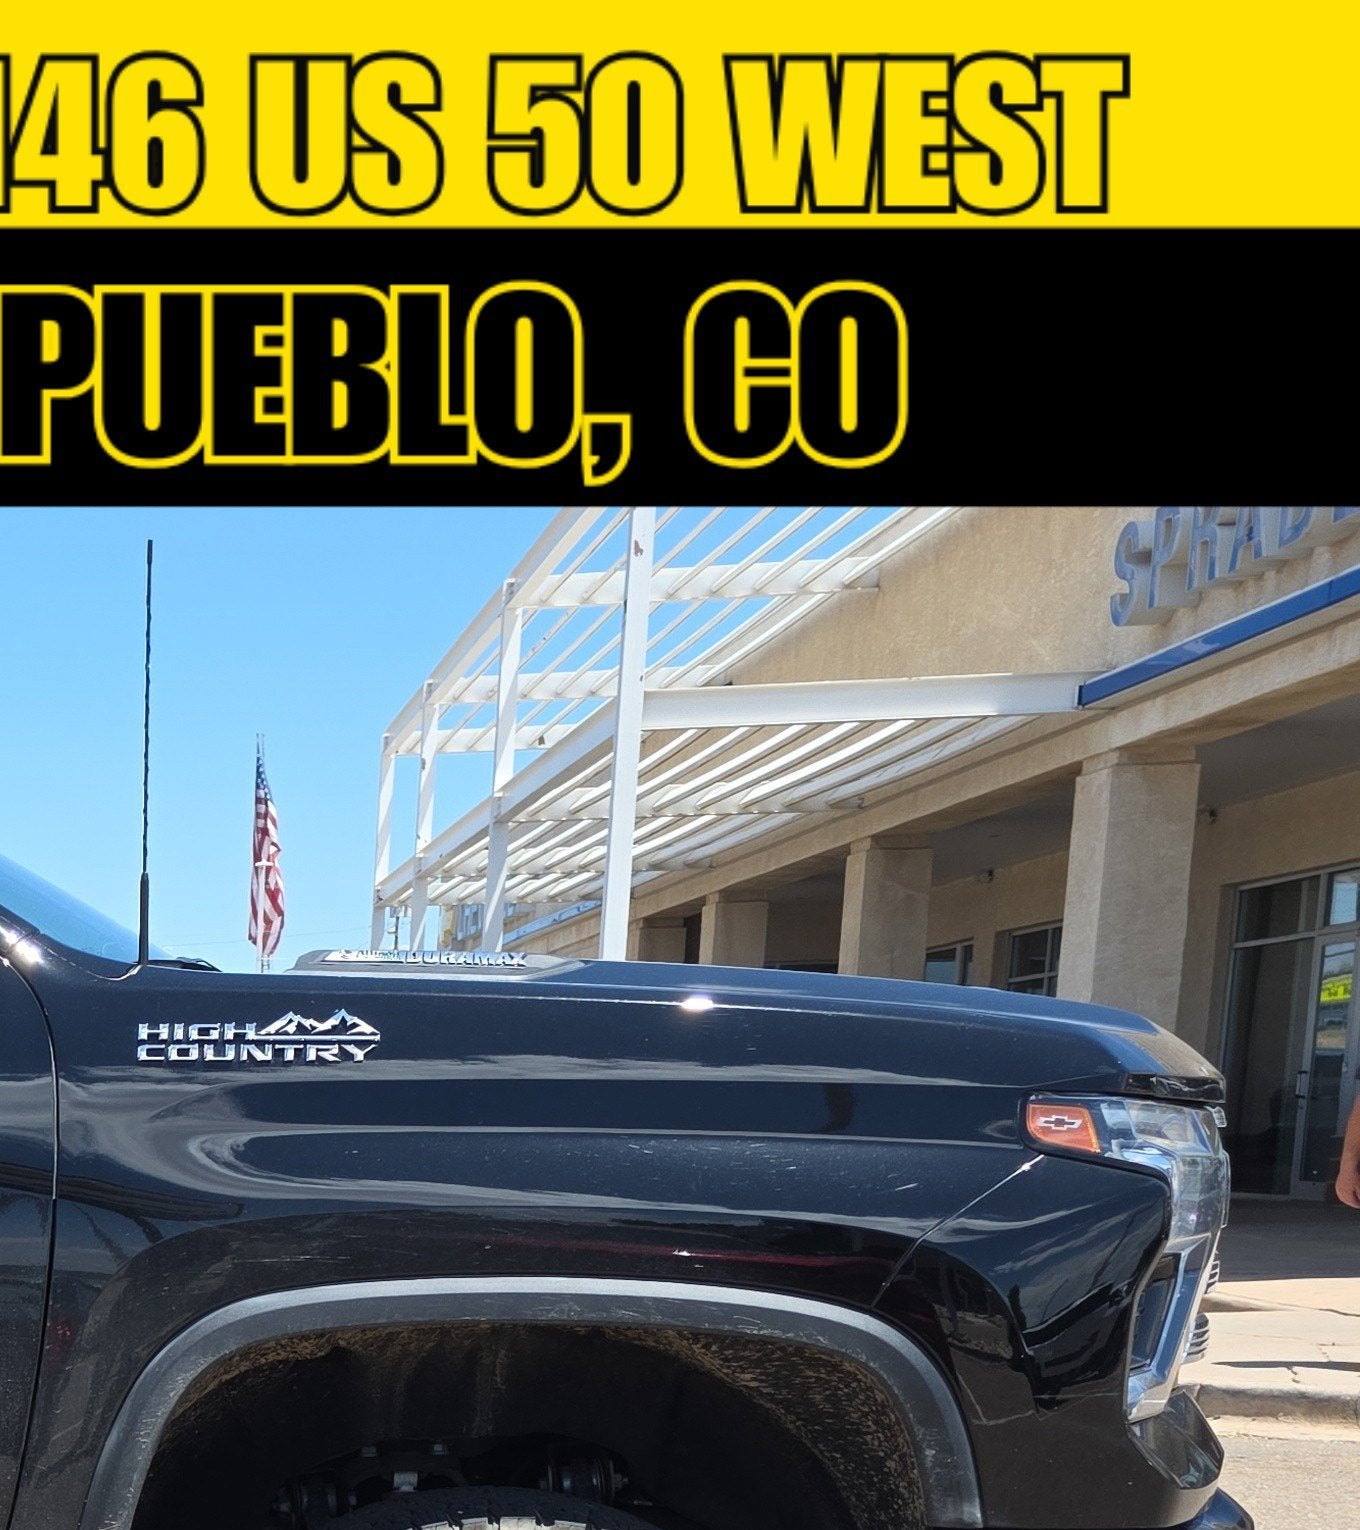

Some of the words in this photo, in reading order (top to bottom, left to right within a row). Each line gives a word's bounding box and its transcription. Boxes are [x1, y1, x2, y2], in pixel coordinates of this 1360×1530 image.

[405, 950, 529, 967] DURAMAX
[136, 1022, 258, 1042] HIGH
[136, 1043, 378, 1064] COUNTRY
